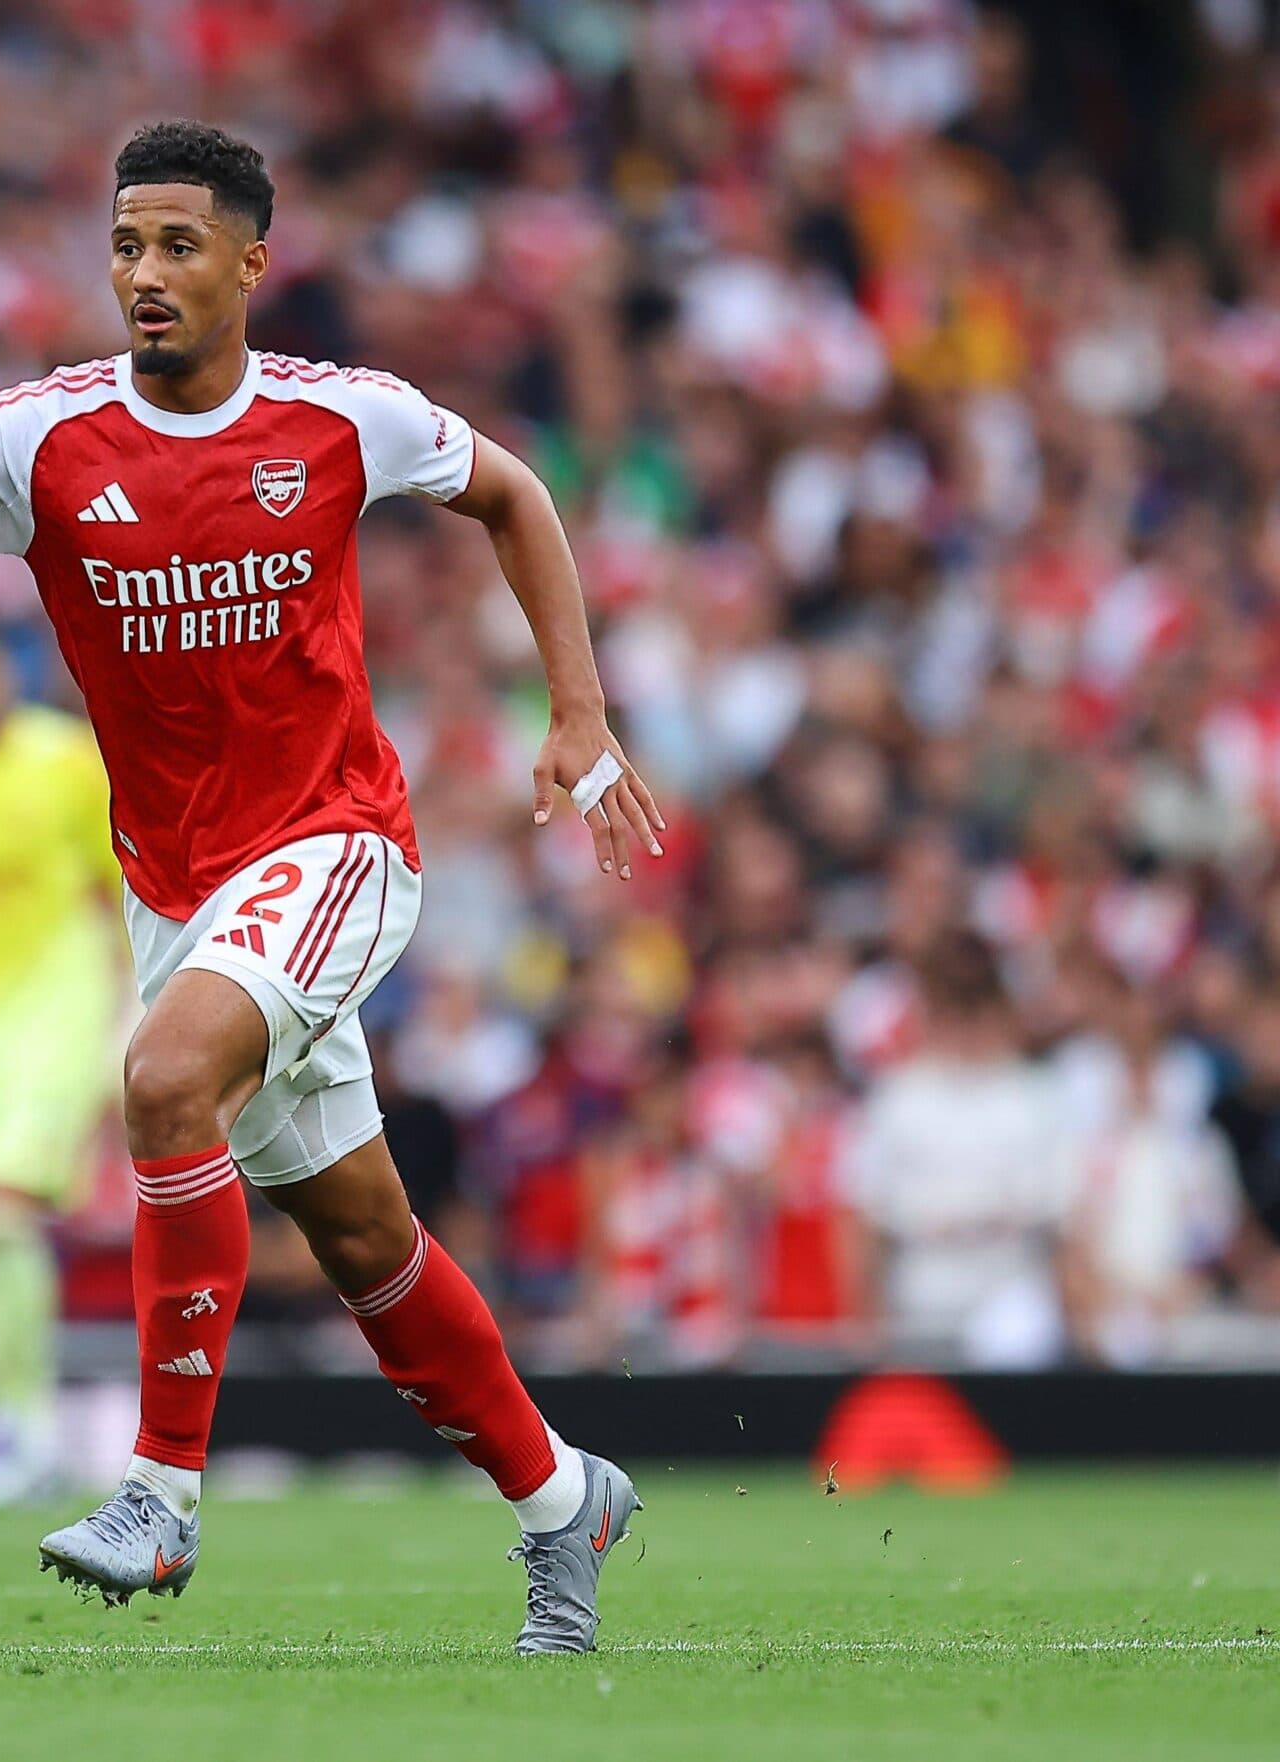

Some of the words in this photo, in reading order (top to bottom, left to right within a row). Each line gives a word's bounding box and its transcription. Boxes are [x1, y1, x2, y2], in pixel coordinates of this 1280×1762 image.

[260, 466, 299, 481] Arsenal
[81, 548, 313, 607] Emirates
[122, 614, 168, 653] FLY
[180, 599, 280, 650] BETTER
[235, 862, 303, 924] 2
